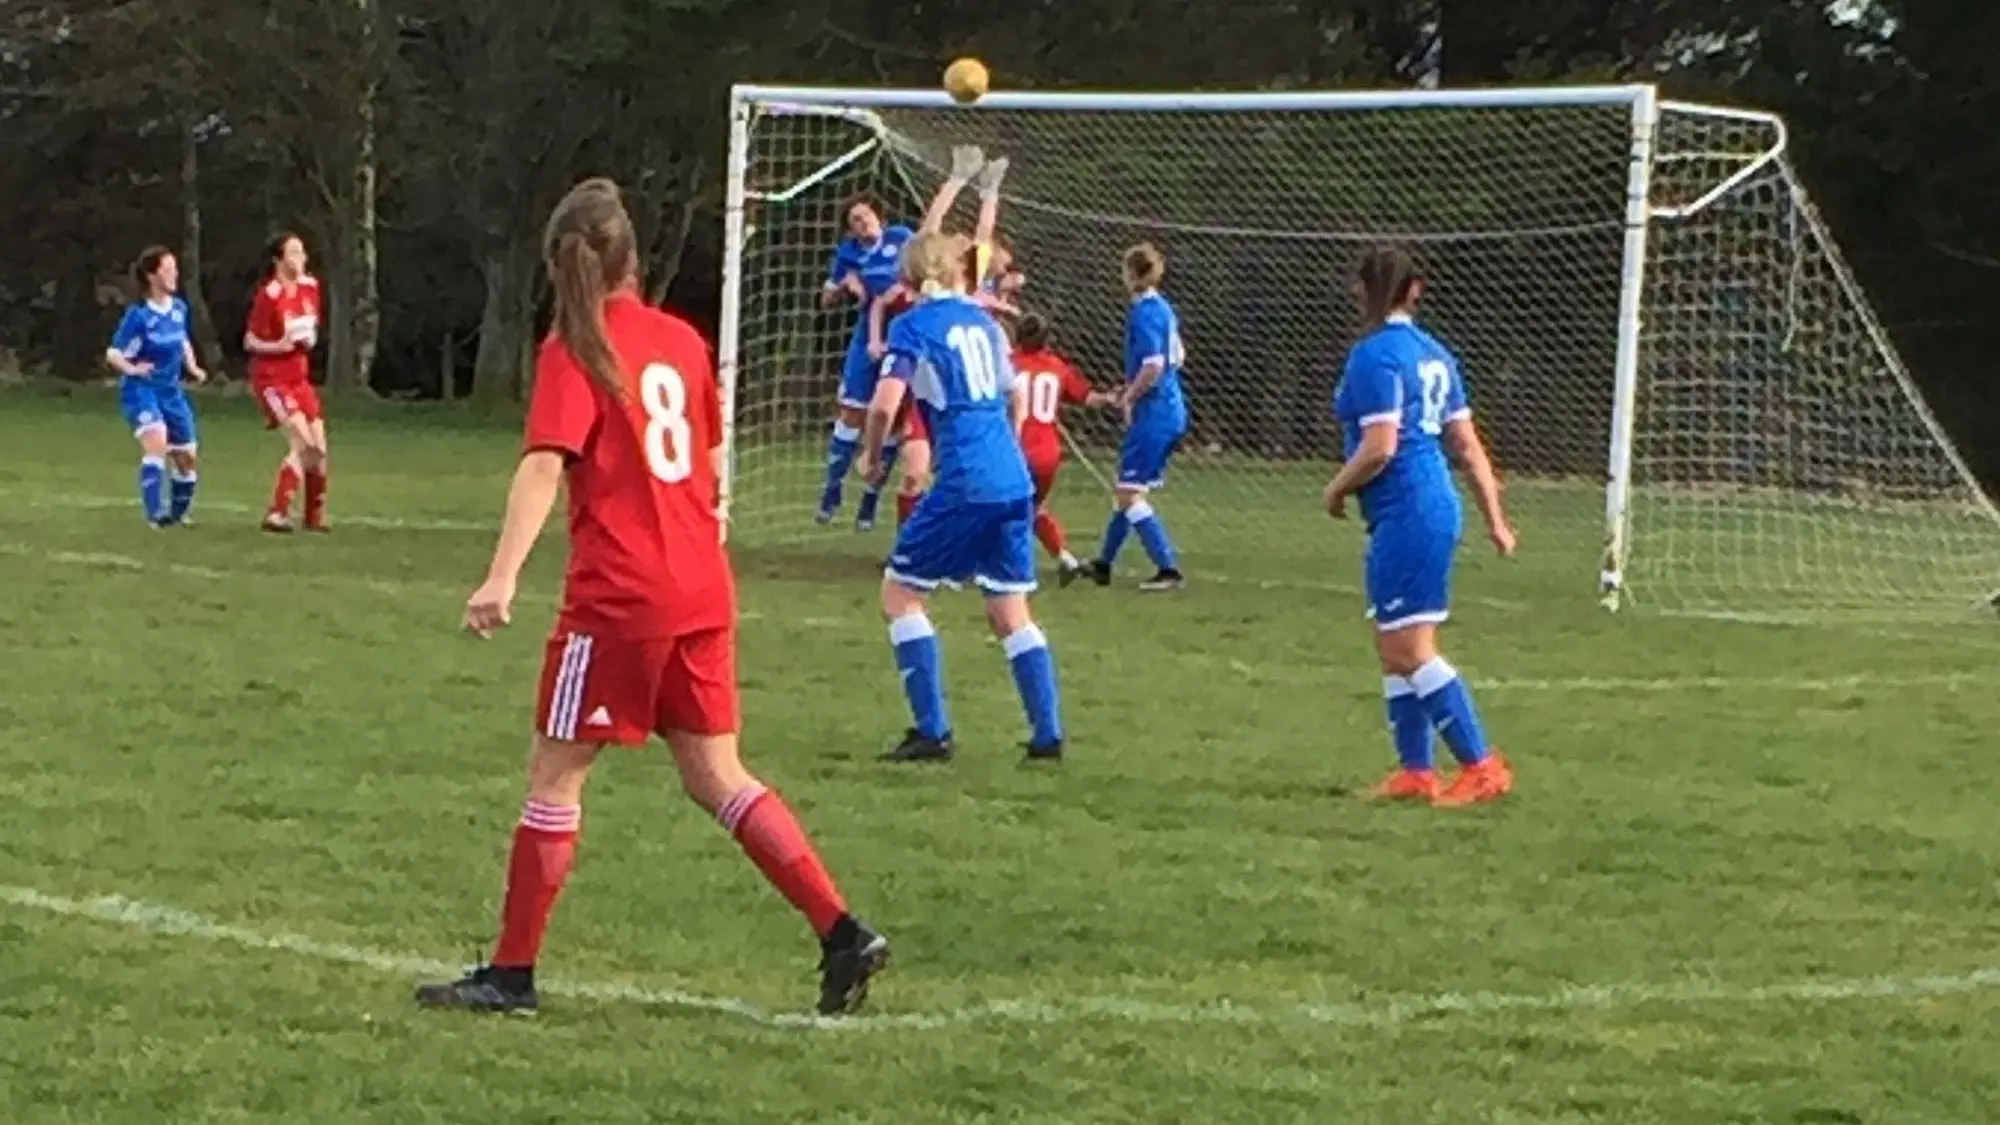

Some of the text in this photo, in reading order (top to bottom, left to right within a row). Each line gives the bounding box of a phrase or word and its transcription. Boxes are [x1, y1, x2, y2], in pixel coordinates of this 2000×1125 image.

[946, 325, 996, 402] 10
[1014, 370, 1060, 424] 10
[640, 362, 692, 483] 8
